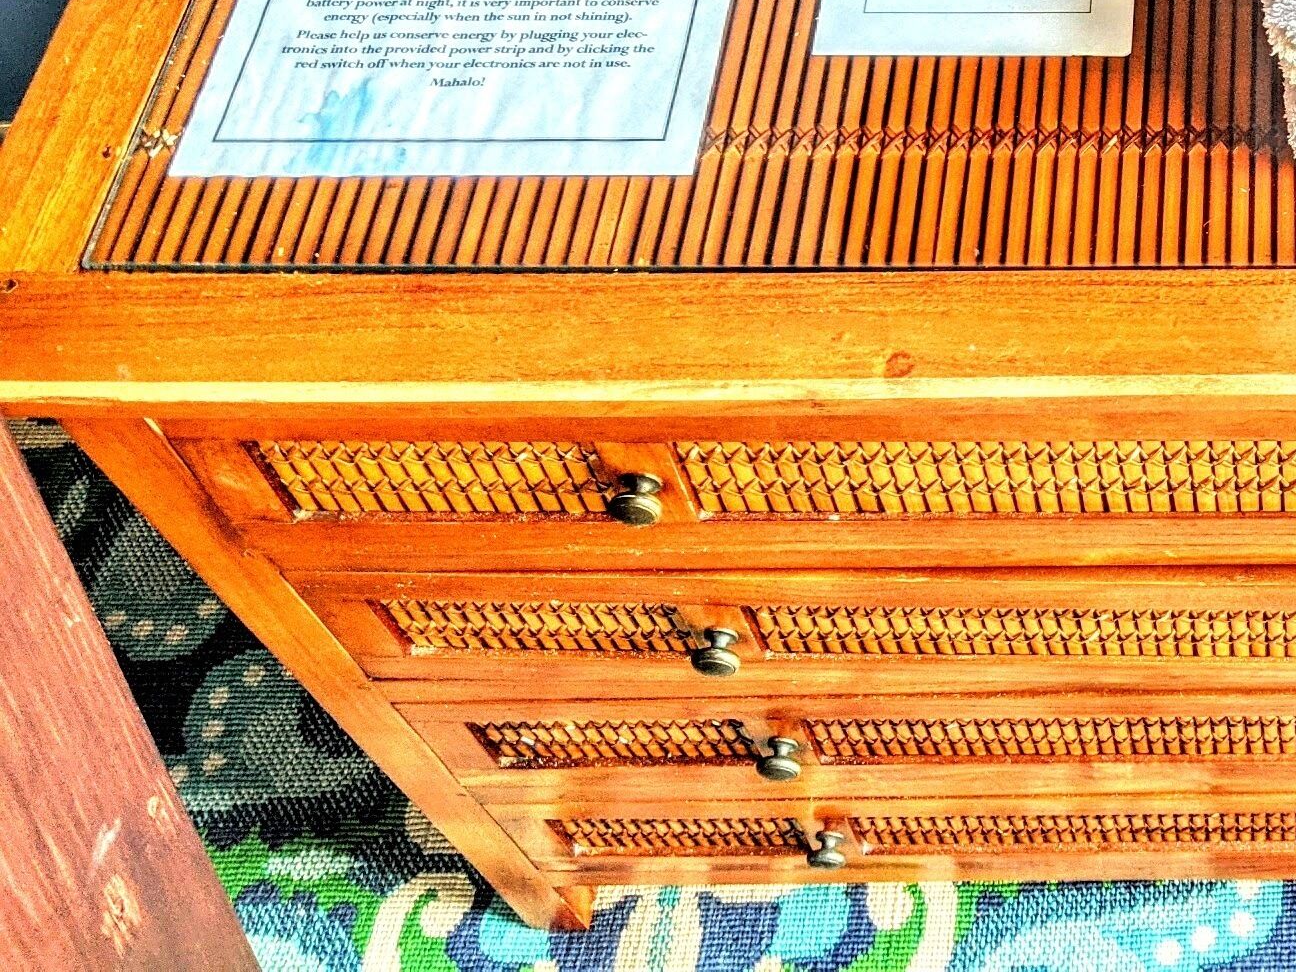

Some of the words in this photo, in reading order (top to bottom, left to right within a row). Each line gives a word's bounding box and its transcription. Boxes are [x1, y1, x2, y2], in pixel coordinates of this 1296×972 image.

[354, 0, 399, 11] power
[399, 0, 413, 8] at
[483, 0, 512, 10] very
[600, 0, 660, 7] conserve
[323, 14, 369, 25] energy
[370, 12, 441, 25] (especially
[443, 12, 481, 22] when
[483, 12, 505, 22] the
[533, 12, 547, 21] in
[549, 13, 572, 21] not
[574, 12, 633, 25] shining).
[295, 29, 338, 40] Please
[339, 29, 370, 43] help
[372, 32, 388, 40] us
[389, 32, 450, 40] conserve
[451, 32, 498, 43] energy
[500, 30, 517, 43] by
[518, 30, 579, 43] plugging
[580, 32, 614, 42] your
[615, 29, 648, 40] elec-
[280, 44, 329, 55] tronics
[329, 44, 358, 54] into
[360, 44, 383, 54] the
[383, 44, 447, 57] provided
[447, 46, 493, 57] power
[493, 44, 527, 57] strip
[527, 44, 555, 54] and
[556, 44, 575, 57] by
[576, 44, 631, 56] clicking
[632, 44, 655, 53] the
[293, 59, 319, 69] red
[319, 59, 364, 69] switch
[366, 59, 388, 69] off
[388, 58, 426, 69] when
[425, 61, 462, 71] your
[462, 59, 537, 69] electronics
[562, 60, 587, 69] not
[588, 59, 603, 69] in
[605, 60, 632, 68] use.
[429, 76, 486, 88] Mahalo!
